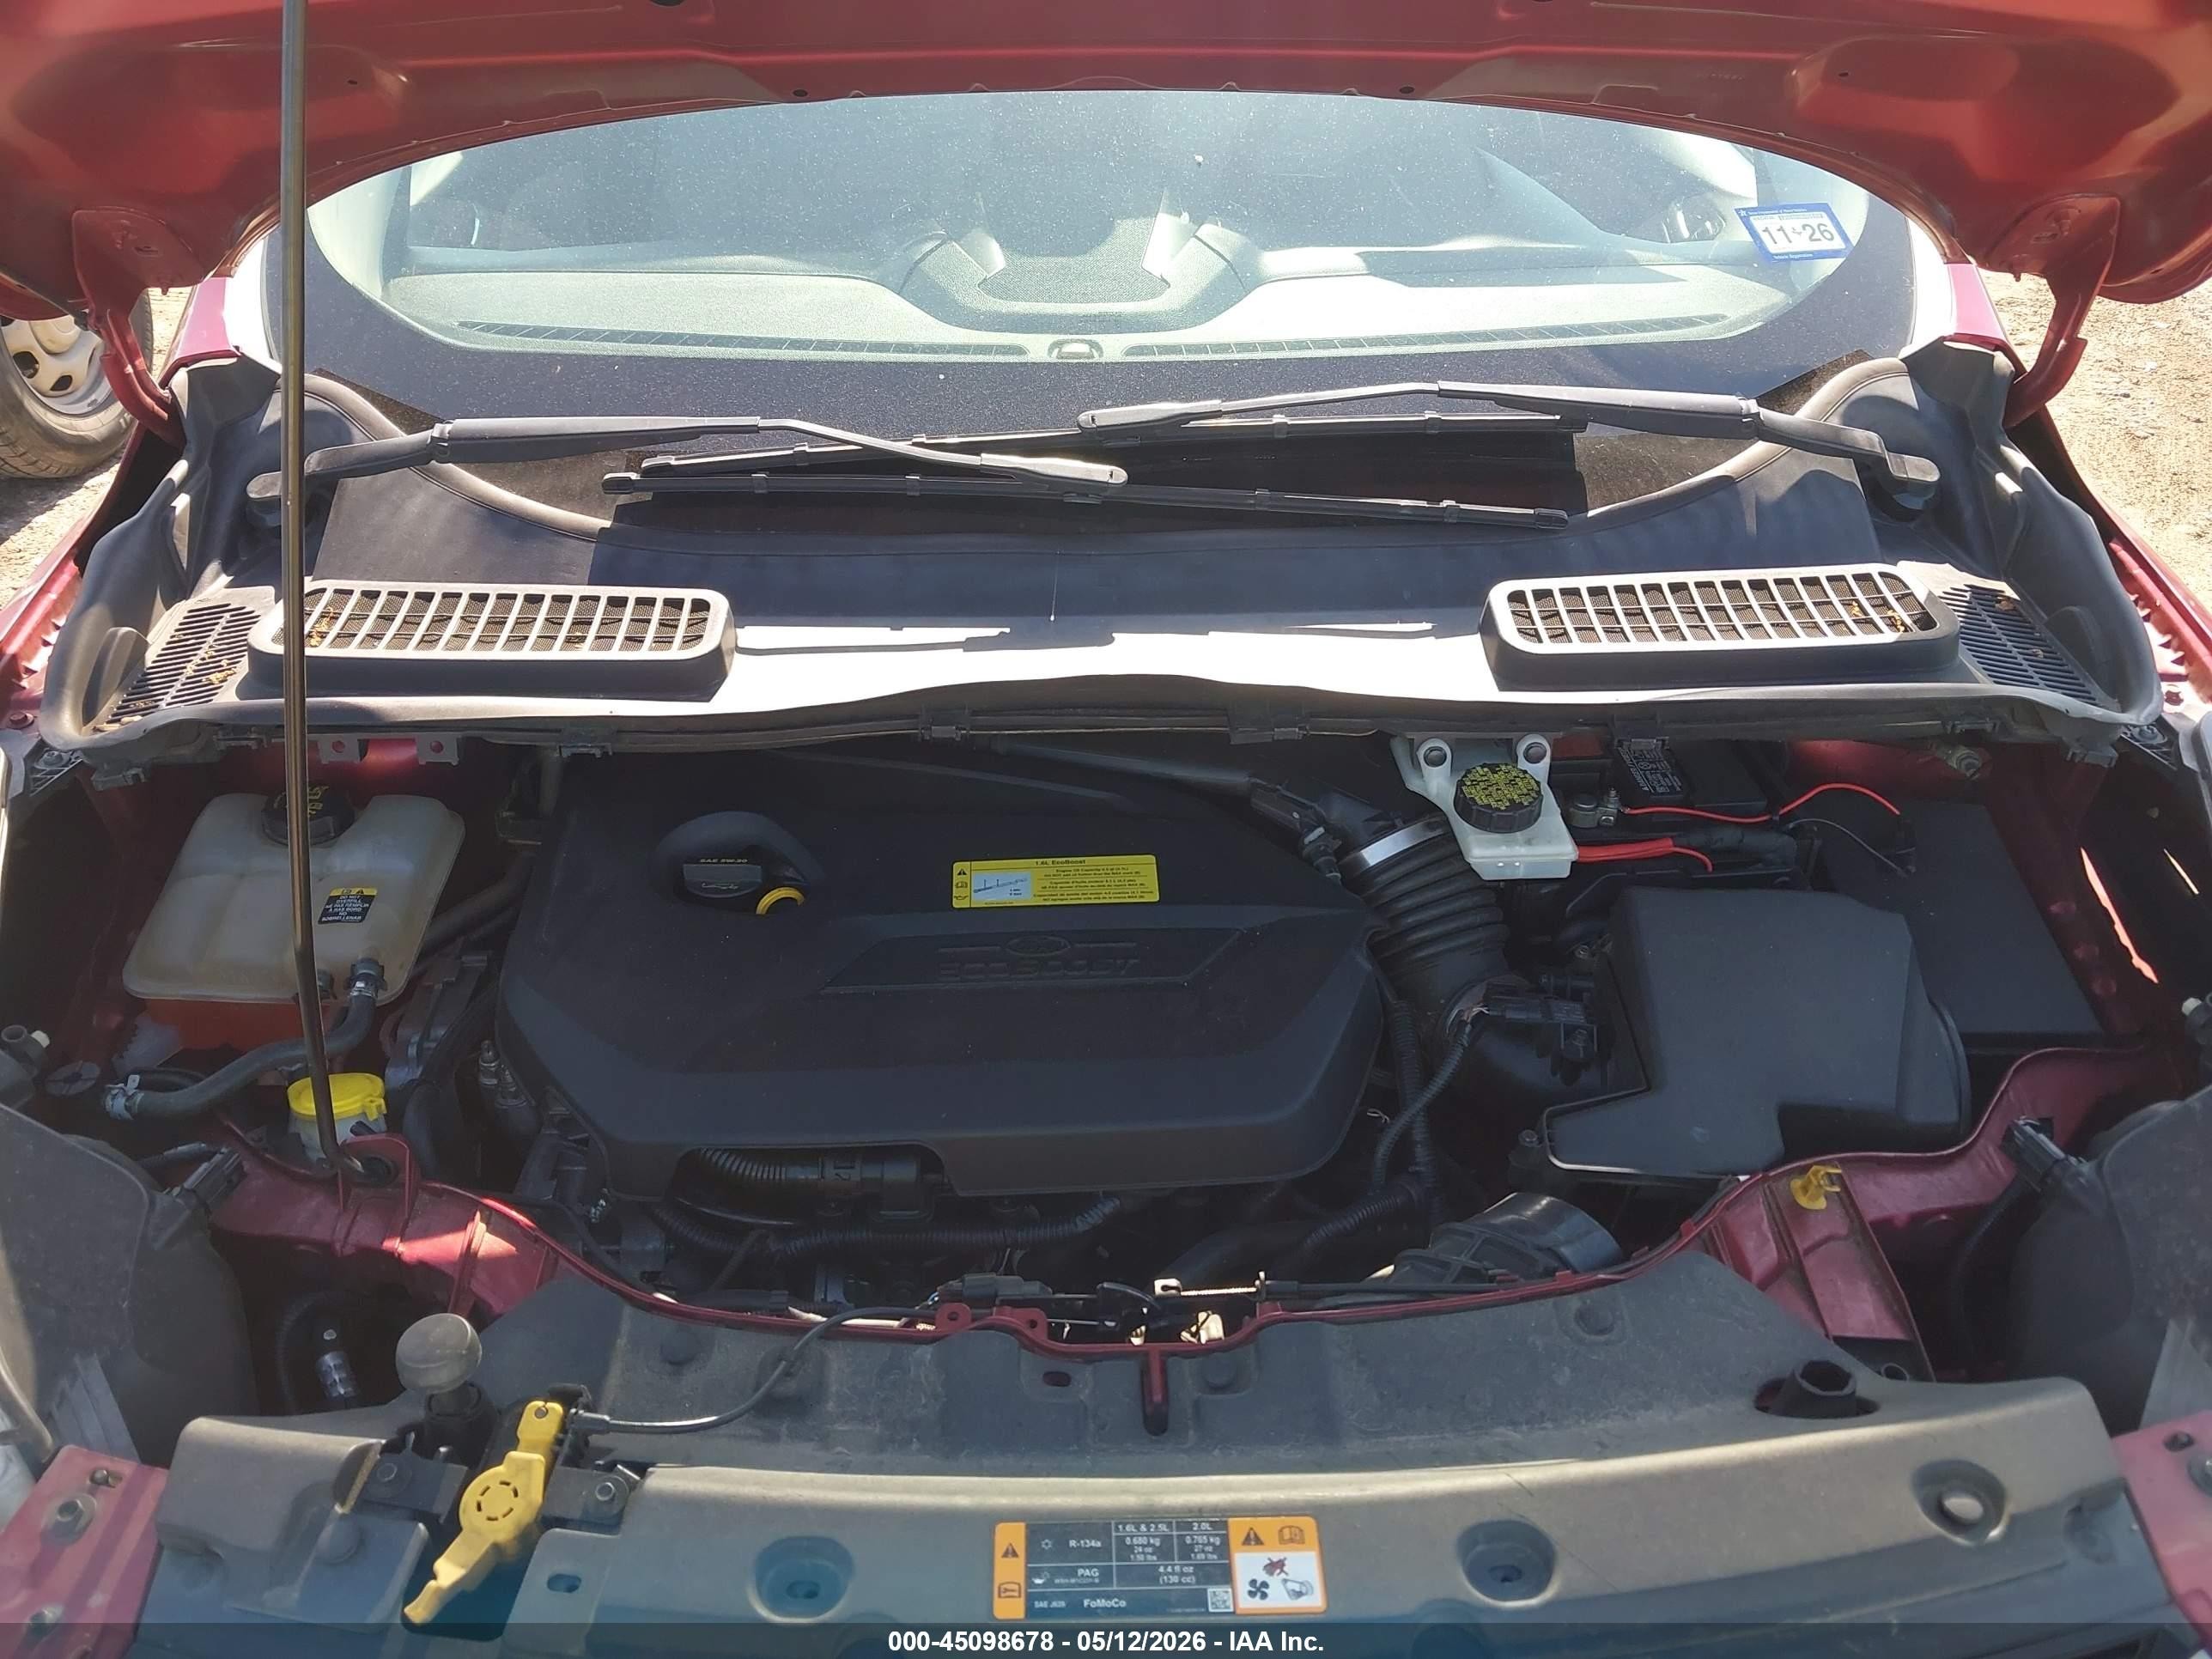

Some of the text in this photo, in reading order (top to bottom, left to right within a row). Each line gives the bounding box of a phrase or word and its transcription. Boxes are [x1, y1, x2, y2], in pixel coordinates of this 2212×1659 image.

[1139, 1523, 1148, 1532] &
[1078, 1568, 1099, 1577] PAG
[1083, 1598, 1127, 1607] FoMoCo
